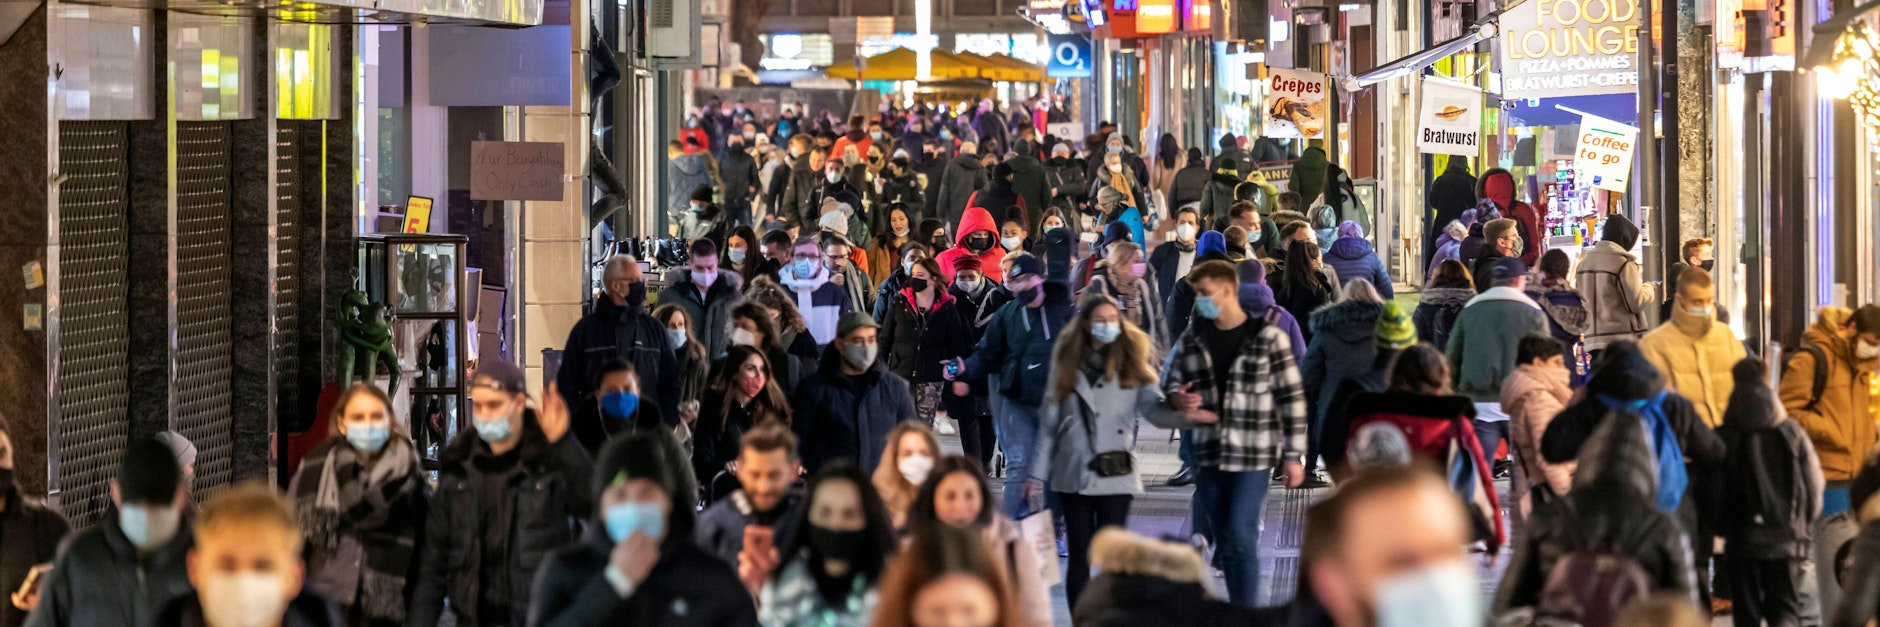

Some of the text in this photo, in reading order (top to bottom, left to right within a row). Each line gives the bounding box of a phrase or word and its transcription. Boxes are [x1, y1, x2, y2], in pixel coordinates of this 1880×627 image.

[1536, 0, 1635, 26] FOOD
[1507, 24, 1638, 59] LOUNGE
[1055, 41, 1085, 70] O2
[1519, 55, 1630, 74] PIZZA POMMES
[1272, 74, 1321, 97] Crêpes
[1506, 73, 1590, 91] BRATWURST
[1423, 127, 1477, 146] Bratwurst
[1582, 133, 1630, 152] Coffee
[475, 145, 502, 165] Nur
[1580, 147, 1620, 165] to go
